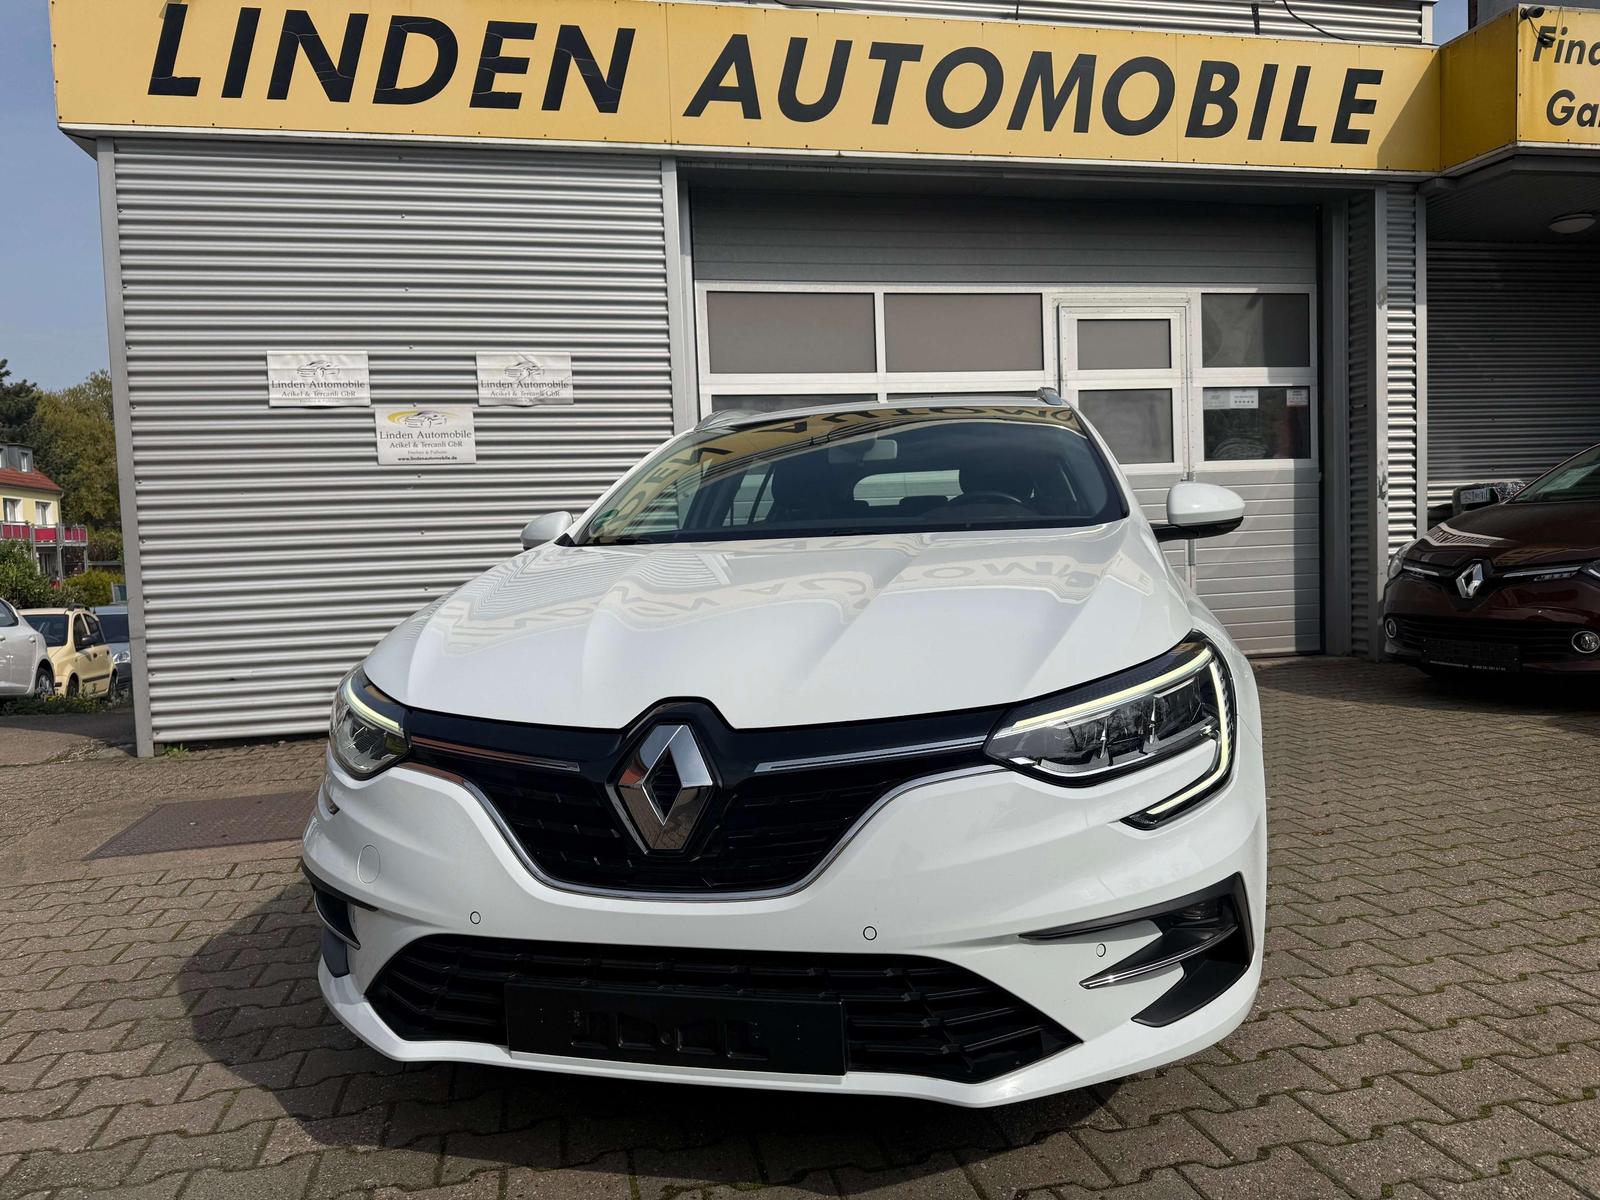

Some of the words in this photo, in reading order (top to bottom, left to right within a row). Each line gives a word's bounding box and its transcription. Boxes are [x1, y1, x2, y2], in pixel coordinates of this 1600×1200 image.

[148, 4, 635, 114] LINDEN
[683, 33, 1384, 145] AUTOMOBILE
[1546, 88, 1600, 128] Ga
[271, 380, 306, 389] Linden
[309, 380, 366, 389] Automobile
[480, 380, 513, 389] Linden
[516, 380, 569, 389] Automobile
[379, 431, 414, 440] Linden
[416, 430, 472, 439] Automobile
